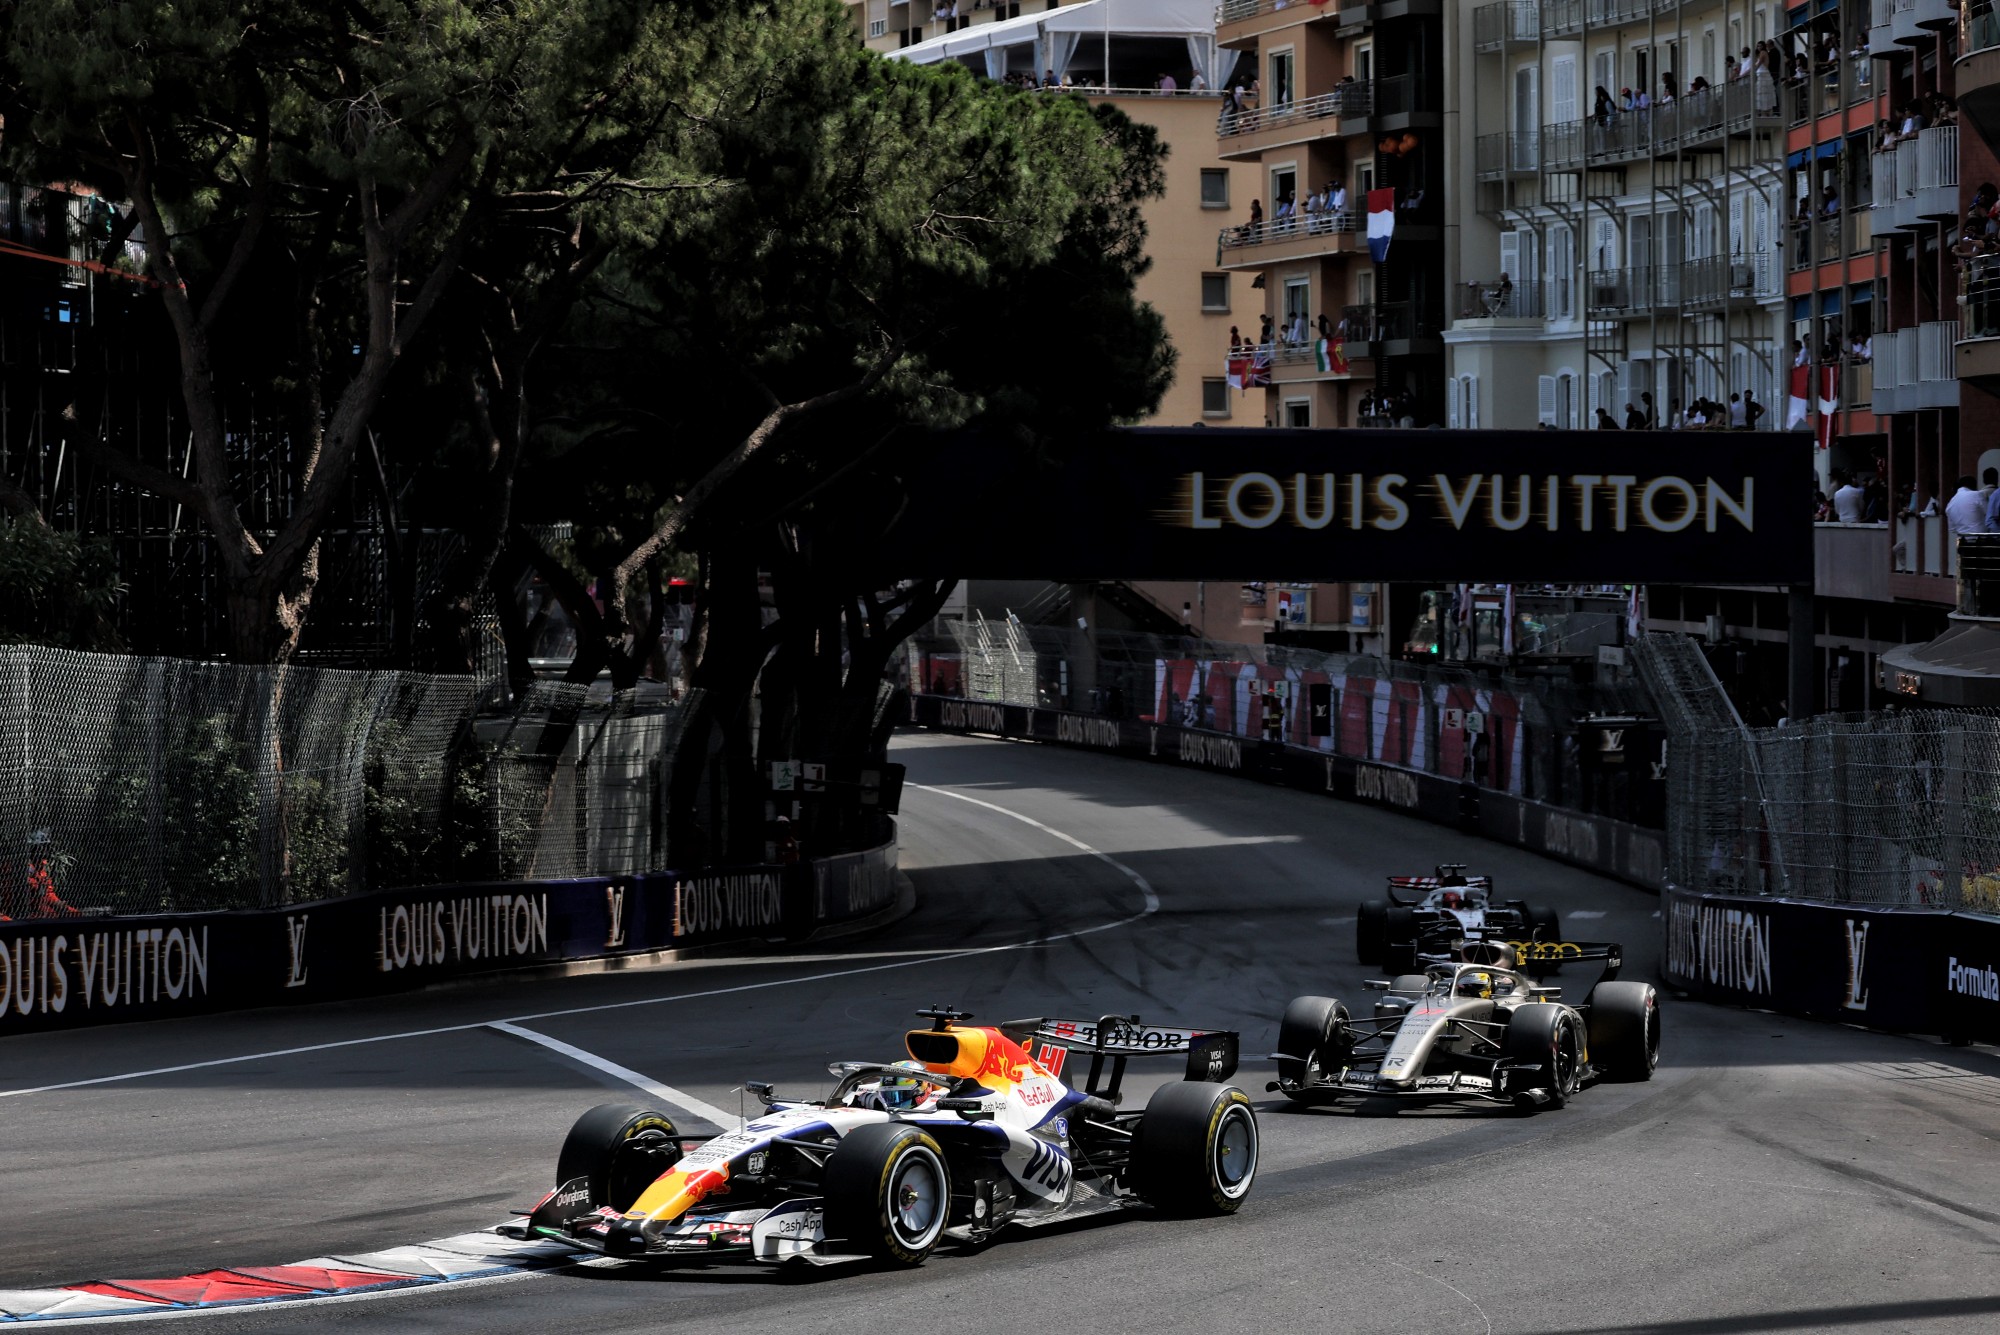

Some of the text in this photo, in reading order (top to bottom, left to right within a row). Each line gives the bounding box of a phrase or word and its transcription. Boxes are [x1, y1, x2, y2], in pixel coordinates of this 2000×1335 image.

[1191, 471, 1755, 533] LOUIS VUITTON
[941, 701, 1005, 732] LOUIS VUITTON
[1057, 713, 1119, 748] LOUIS VUITTON
[1180, 731, 1241, 769] LOUIS VUITTON
[1355, 763, 1419, 808] LOUIS VUITTON
[673, 872, 782, 937] LOUIS VUITTON
[382, 892, 547, 972] LOUIS VUITTON
[1668, 901, 1772, 996] LOUIS VUITTON
[78, 925, 208, 1009] VUITTON
[1948, 956, 1999, 1001] Formula
[1082, 1024, 1183, 1049] TUDOR
[1037, 1043, 1068, 1080] 41
[1209, 1050, 1222, 1060] VISA
[1017, 1085, 1055, 1107] Red Bull
[635, 1117, 673, 1132] ZERO
[719, 1134, 758, 1144] VISA
[749, 1156, 764, 1169] FIA
[562, 1189, 589, 1206] dynatrace
[779, 1217, 822, 1234] Cash App
